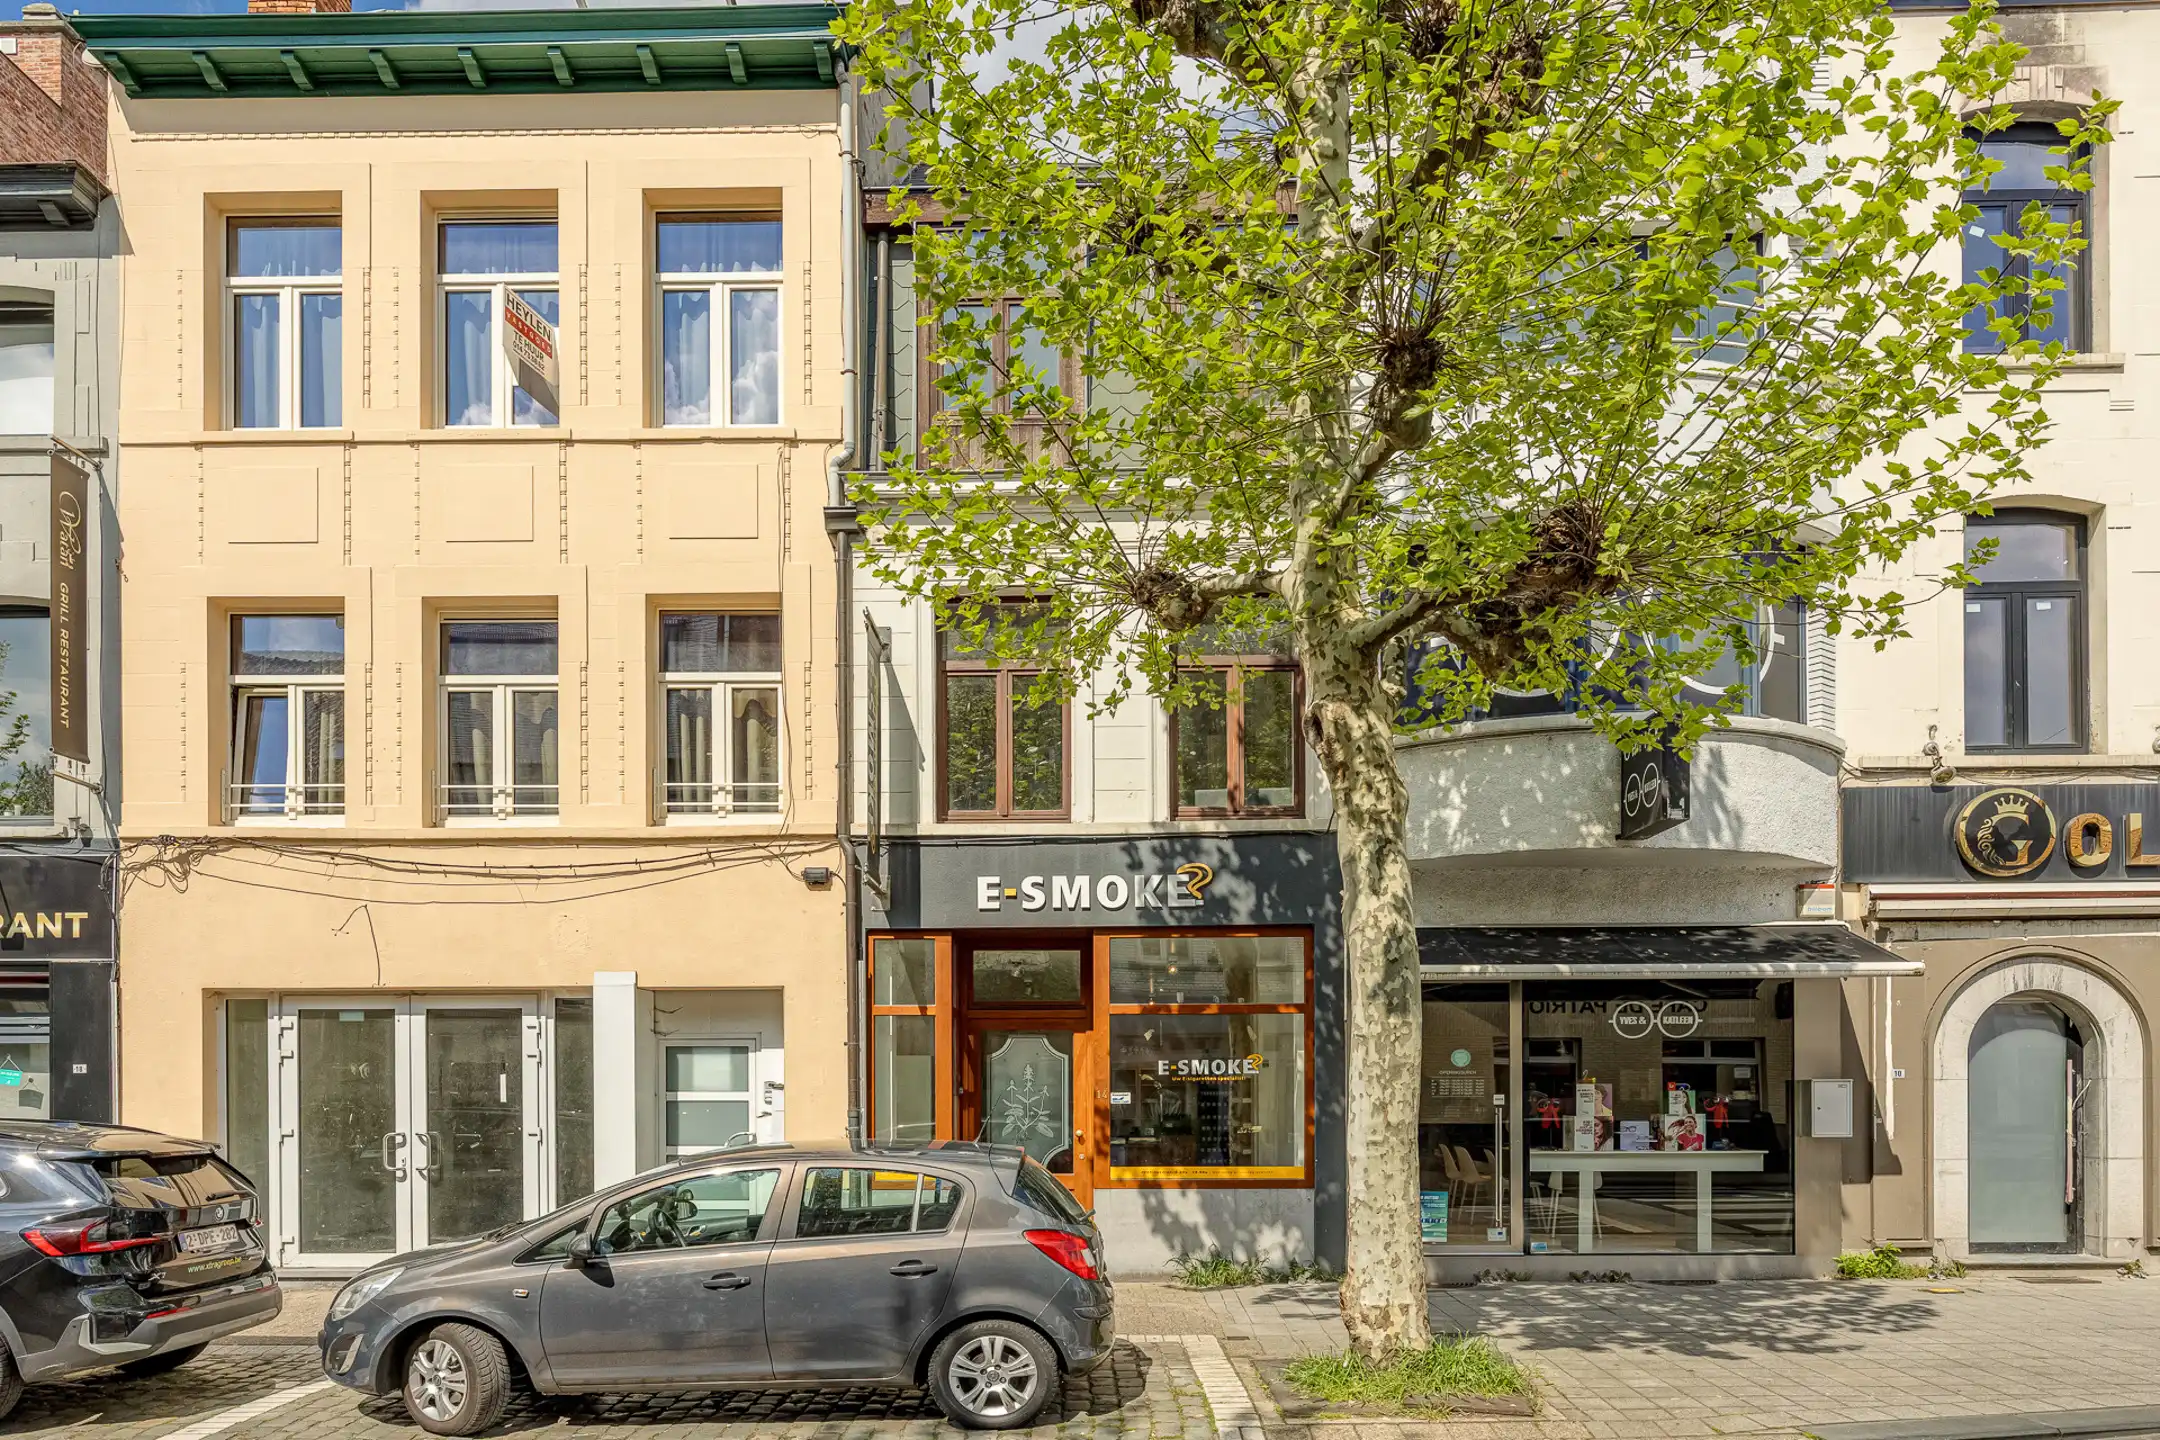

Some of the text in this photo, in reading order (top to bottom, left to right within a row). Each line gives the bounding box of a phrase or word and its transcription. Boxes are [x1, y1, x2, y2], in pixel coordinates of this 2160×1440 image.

[506, 292, 551, 342] HEYLEN
[513, 330, 523, 344] TE
[523, 339, 544, 362] HUUR
[60, 582, 69, 728] GRILL RESTAURANT
[977, 870, 1205, 911] E-SMOKE
[0, 912, 88, 939] ANT
[1620, 1016, 1646, 1025] YVES &
[1662, 1016, 1694, 1025] KATLEEN
[1158, 1058, 1260, 1076] E-SMOKE
[1096, 1089, 1107, 1099] 14
